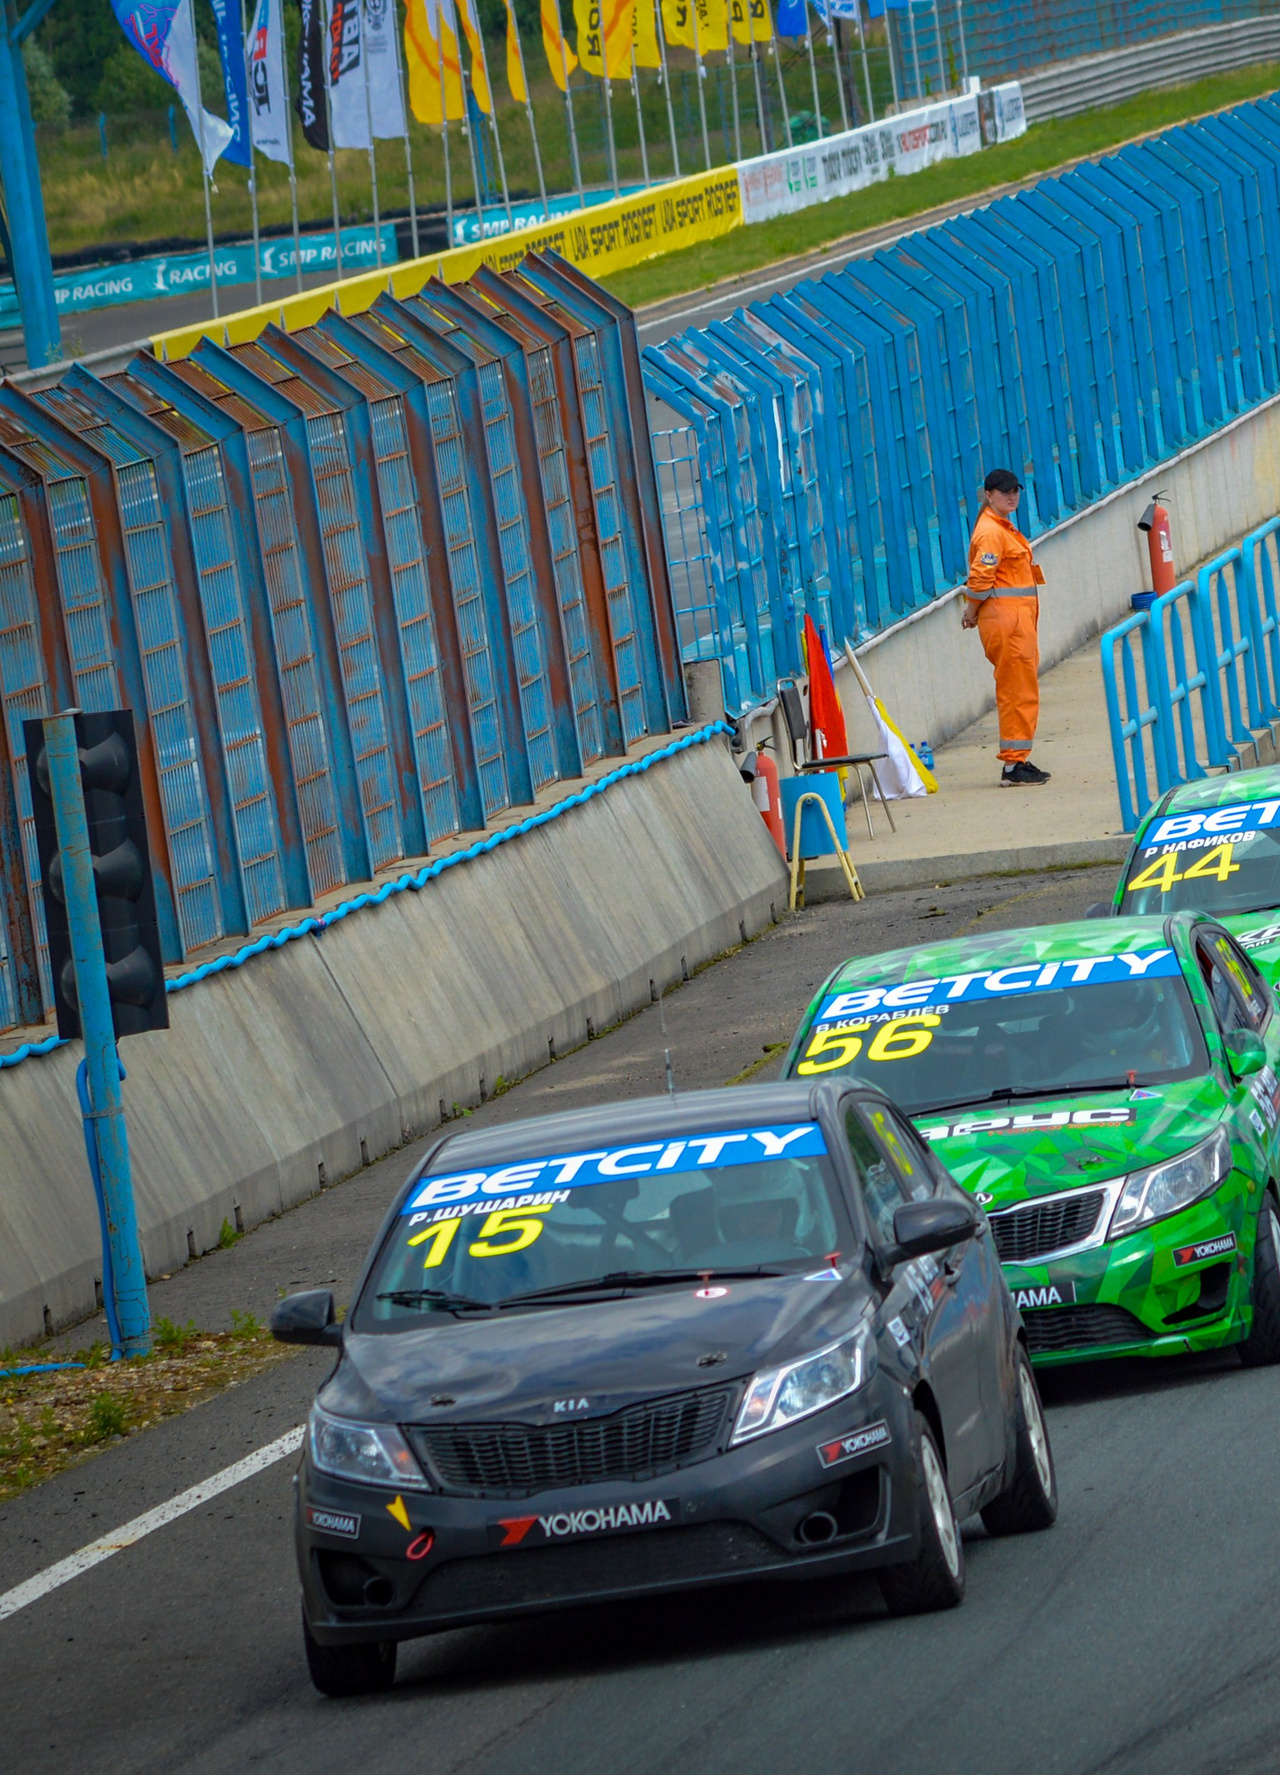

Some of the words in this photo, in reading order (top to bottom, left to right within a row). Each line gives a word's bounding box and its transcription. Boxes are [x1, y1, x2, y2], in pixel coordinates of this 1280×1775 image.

[676, 193, 706, 229] SPORT
[279, 250, 317, 267] SMP
[321, 239, 387, 260] RACING
[590, 219, 622, 256] SPORT
[169, 260, 237, 284] RACING
[72, 278, 133, 300] RACING
[1162, 830, 1257, 855] НАФИКОВ
[1127, 842, 1240, 893] 44
[821, 950, 1173, 1019] BETCITY
[816, 1005, 950, 1034] В.КОРАБЛЁВ
[797, 1014, 942, 1076] 56
[410, 1126, 815, 1208] BETCITY
[408, 1189, 571, 1227] Р.ШУШАРИН
[406, 1203, 553, 1269] 15
[1193, 1237, 1234, 1257] YOKOHAMA
[553, 1397, 590, 1413] KIA
[841, 1425, 888, 1454] YOKOHAMA
[311, 1511, 356, 1534] YOKOHAMA
[539, 1499, 671, 1538] YOKOHAMA
